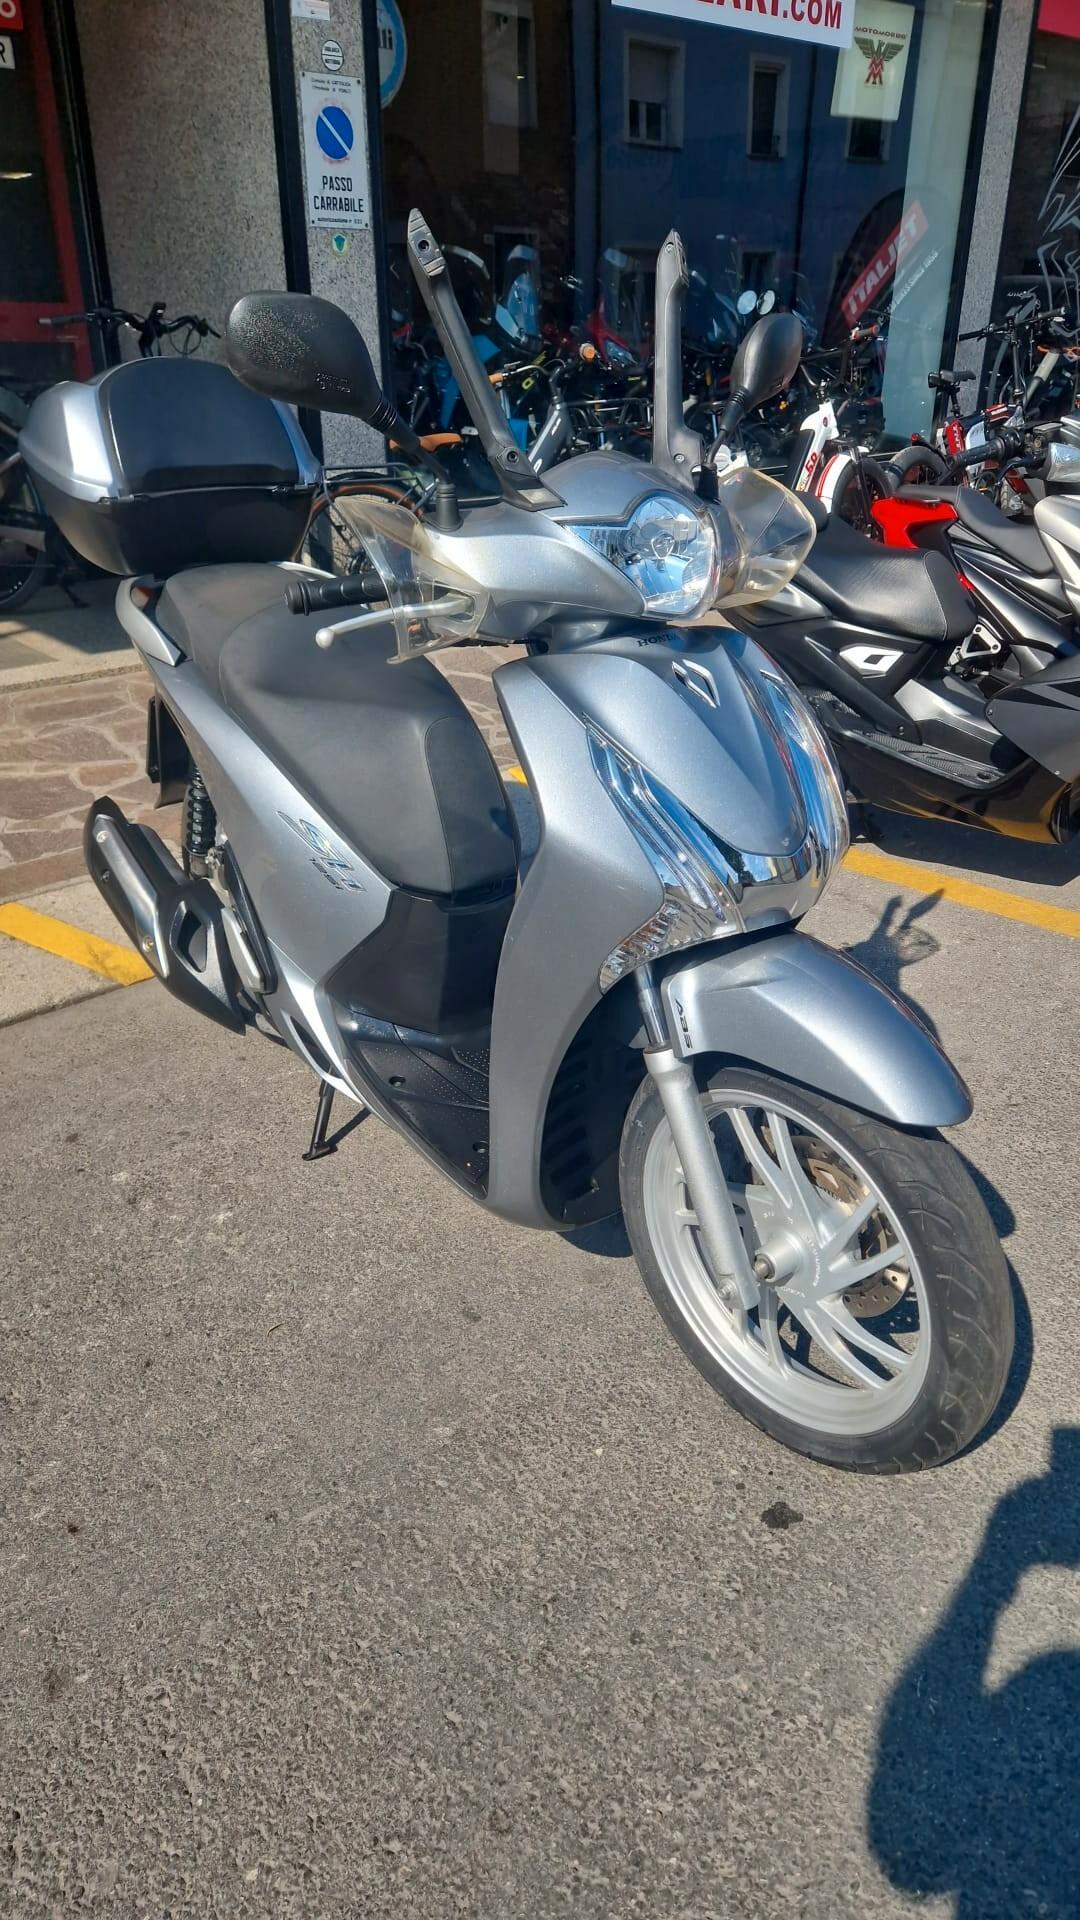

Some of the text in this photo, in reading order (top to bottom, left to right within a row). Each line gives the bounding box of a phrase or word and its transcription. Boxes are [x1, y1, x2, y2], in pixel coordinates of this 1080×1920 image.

[322, 175, 353, 192] PASSO
[313, 195, 365, 213] CARRABILE
[847, 212, 918, 315] ITALJET
[637, 632, 682, 647] HONDA
[674, 998, 694, 1049] ABS
